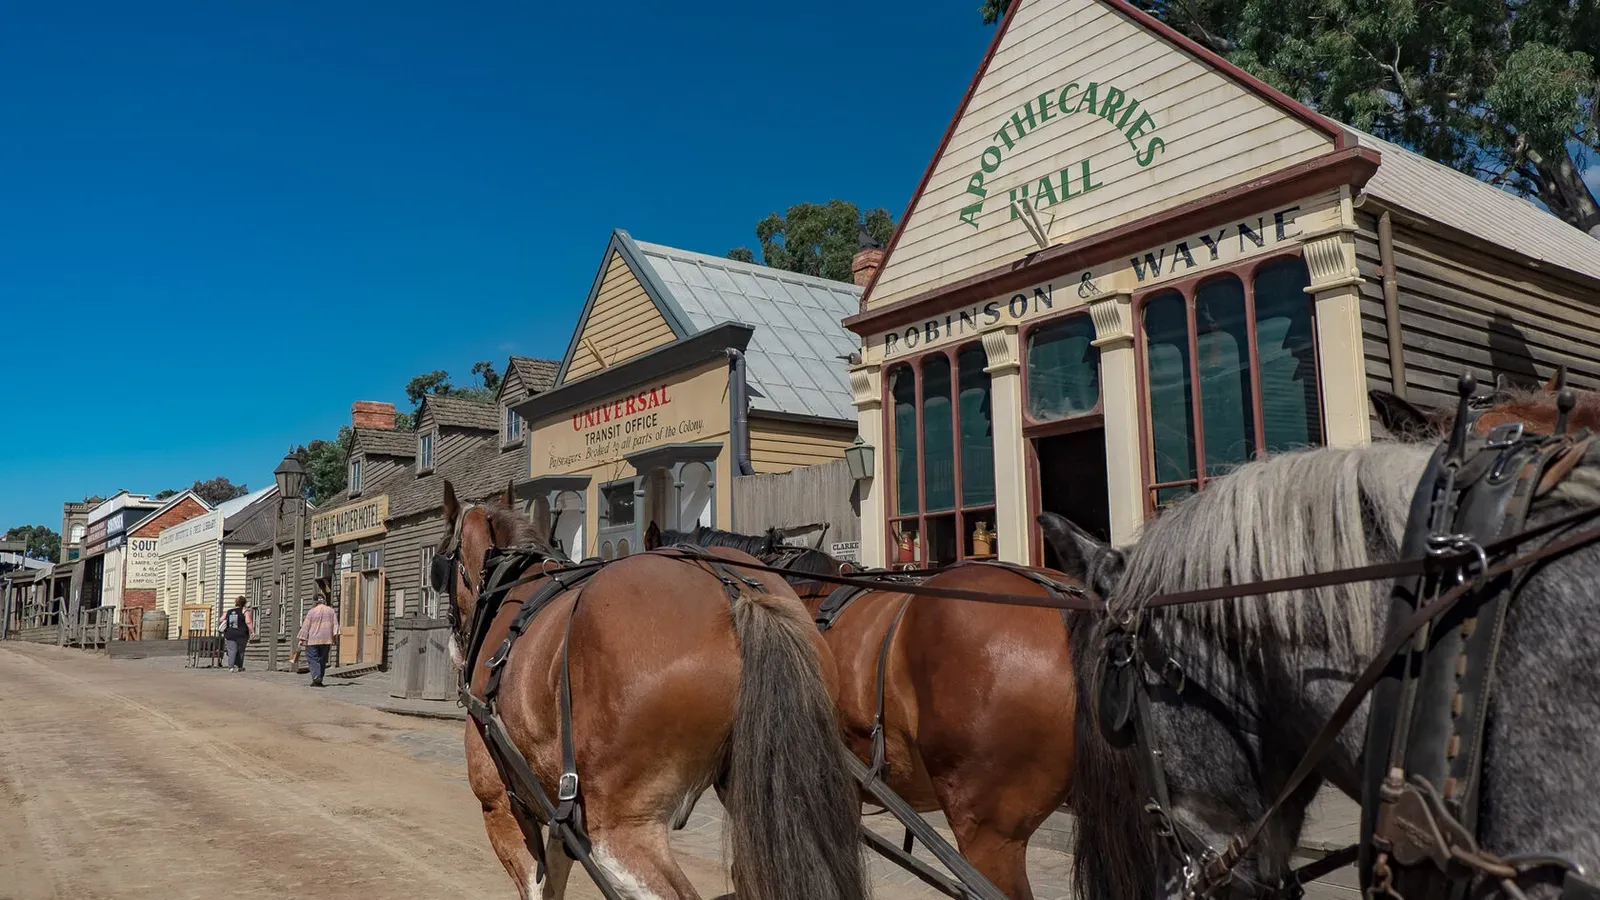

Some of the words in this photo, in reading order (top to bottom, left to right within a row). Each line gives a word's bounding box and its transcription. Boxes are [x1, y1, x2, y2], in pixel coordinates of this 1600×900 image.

[959, 82, 1166, 231] APOTHECARIES
[1009, 159, 1104, 221] HALL
[884, 283, 1054, 358] ROBINSON
[1077, 271, 1102, 300] &
[1130, 206, 1303, 282] WAYNE
[572, 384, 672, 431] UNIVERSAL
[585, 424, 621, 446] TRANSIT
[625, 413, 658, 434] OFFICE
[621, 437, 632, 449] all
[632, 433, 653, 449] parts
[655, 427, 664, 441] of
[665, 425, 676, 438] the
[132, 540, 158, 551] SOUT
[832, 542, 859, 550] CLARKE
